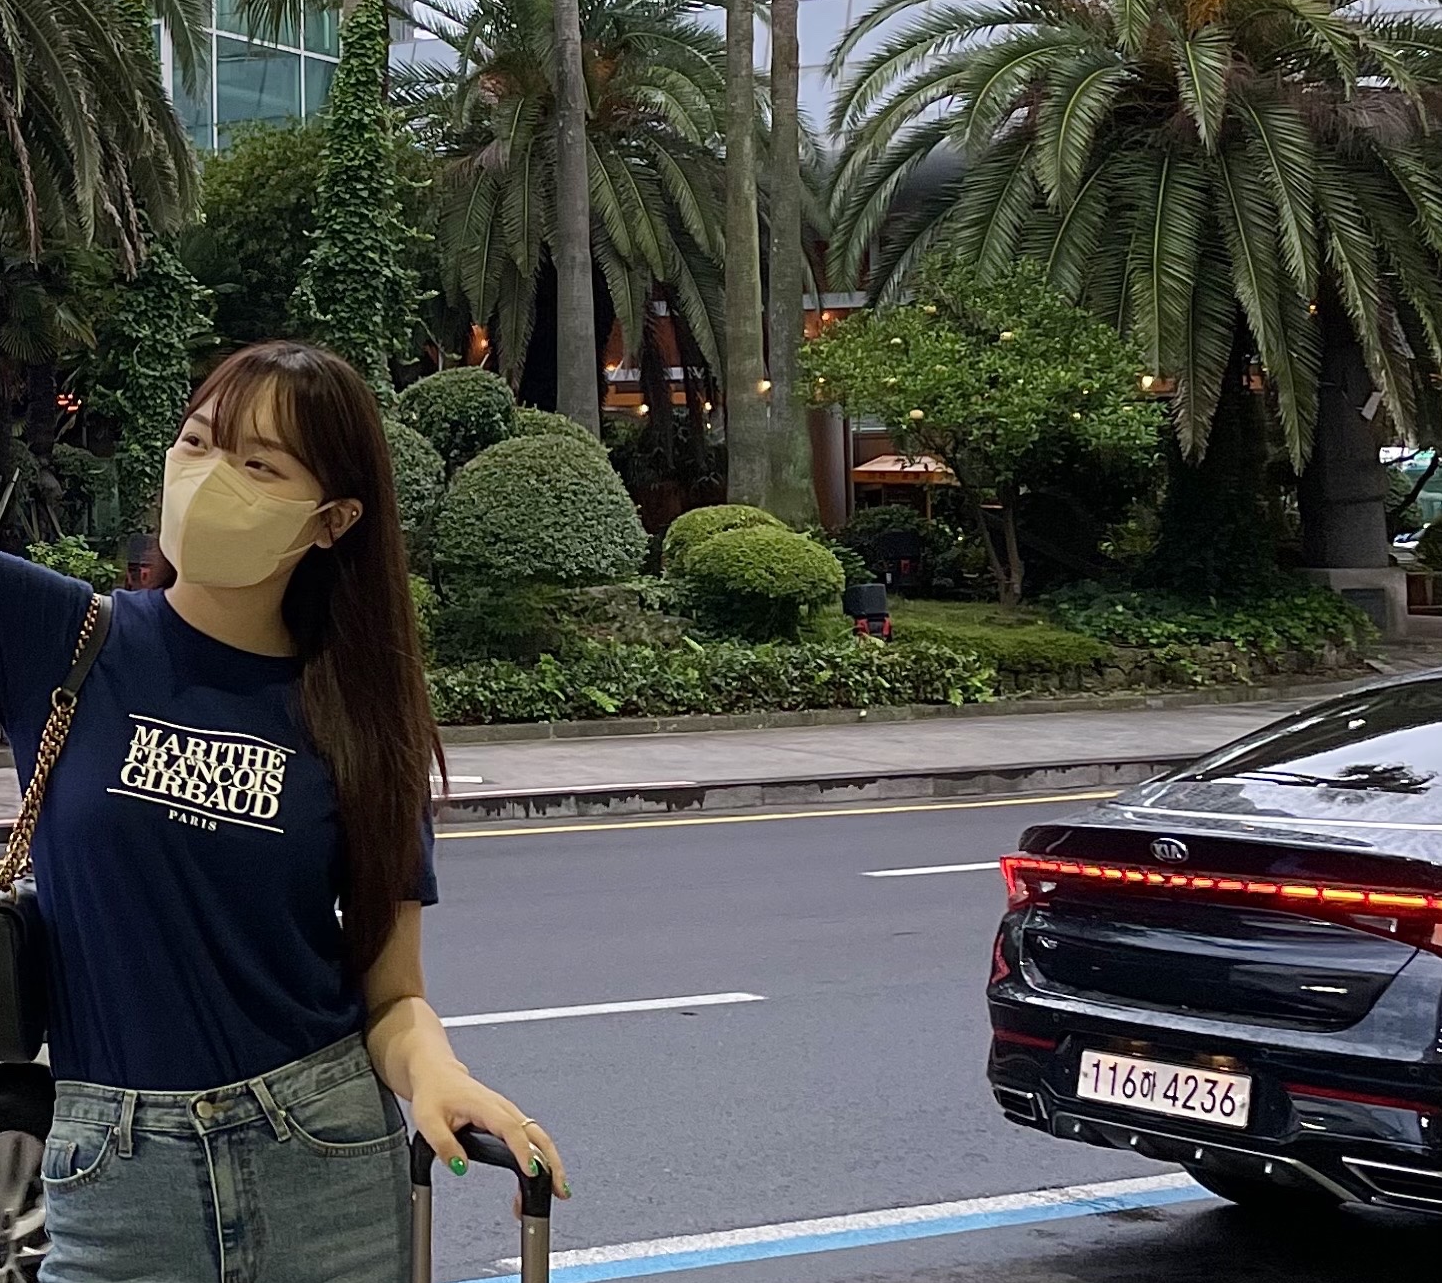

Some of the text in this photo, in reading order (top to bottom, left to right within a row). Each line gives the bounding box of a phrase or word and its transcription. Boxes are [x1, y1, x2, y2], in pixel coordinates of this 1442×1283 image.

[132, 724, 287, 775] MARITHÉ
[120, 762, 280, 820] GIRBAUD
[168, 809, 218, 832] PARIS
[1092, 1059, 1236, 1117] 116하 4236
